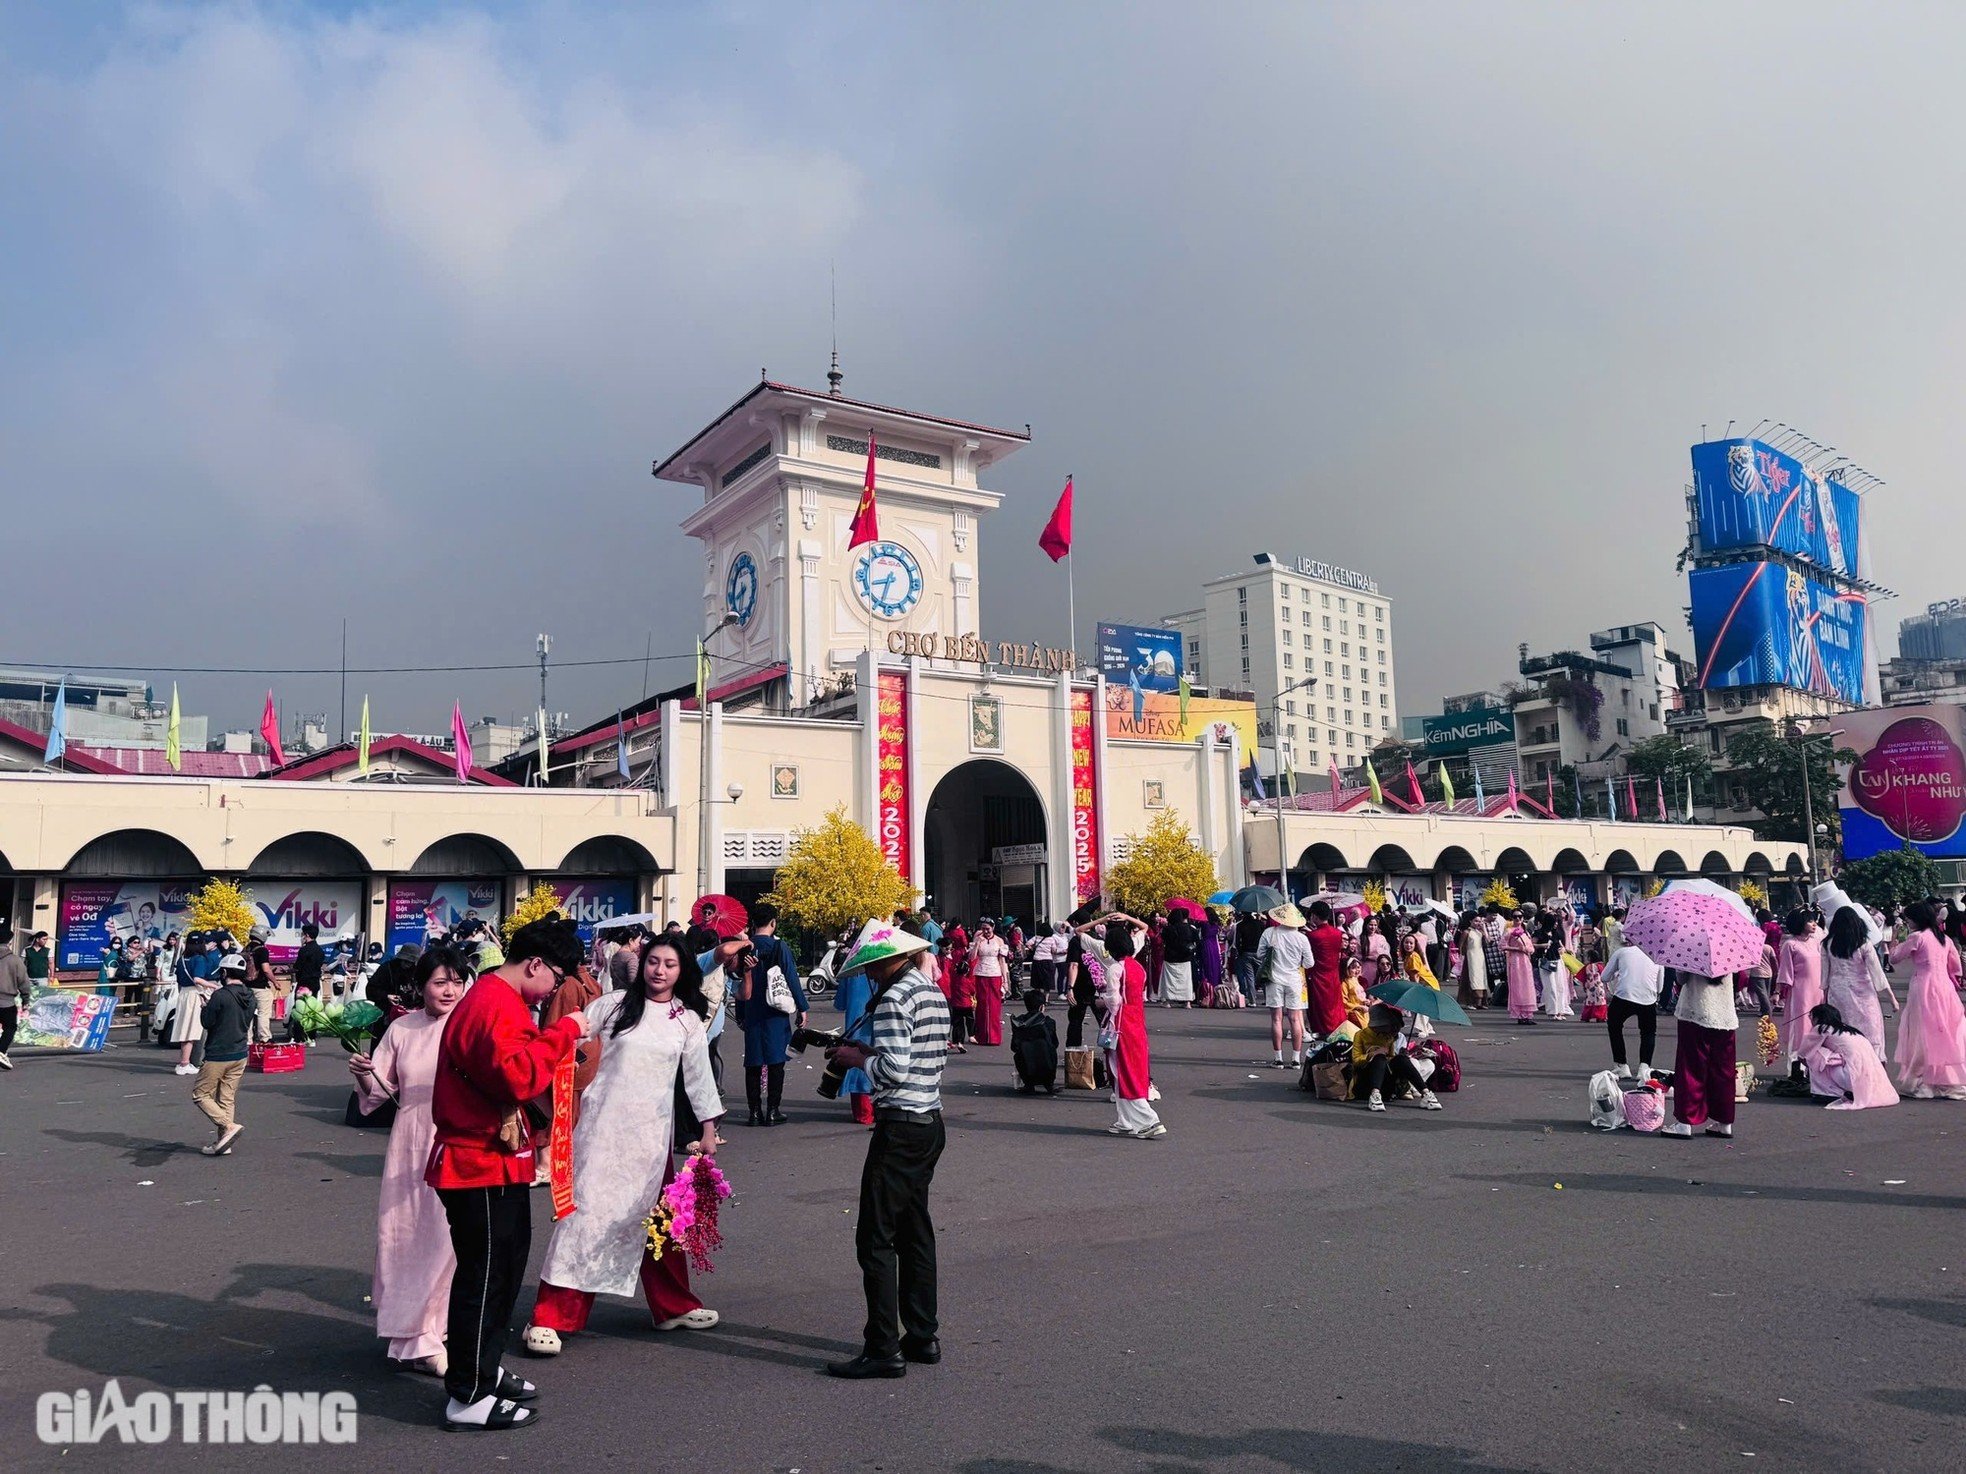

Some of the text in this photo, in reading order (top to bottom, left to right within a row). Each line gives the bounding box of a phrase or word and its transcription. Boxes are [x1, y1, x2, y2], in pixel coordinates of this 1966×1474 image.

[1757, 449, 1790, 494] Tiger
[1296, 556, 1373, 590] LIBERTY CENTRAL
[887, 629, 1076, 674] CHỢ BẾN THÀNH
[1118, 716, 1186, 737] MUFASA
[1073, 748, 1090, 768] NEW
[1892, 772, 1952, 787] KHANG
[1075, 811, 1091, 874] 2025
[71, 895, 113, 903] Chạm tay,
[160, 887, 188, 903] Vikk
[469, 885, 494, 899] Vikki
[1392, 880, 1423, 906] Vikki
[82, 912, 98, 921] 0đ
[256, 888, 338, 929] Vikki
